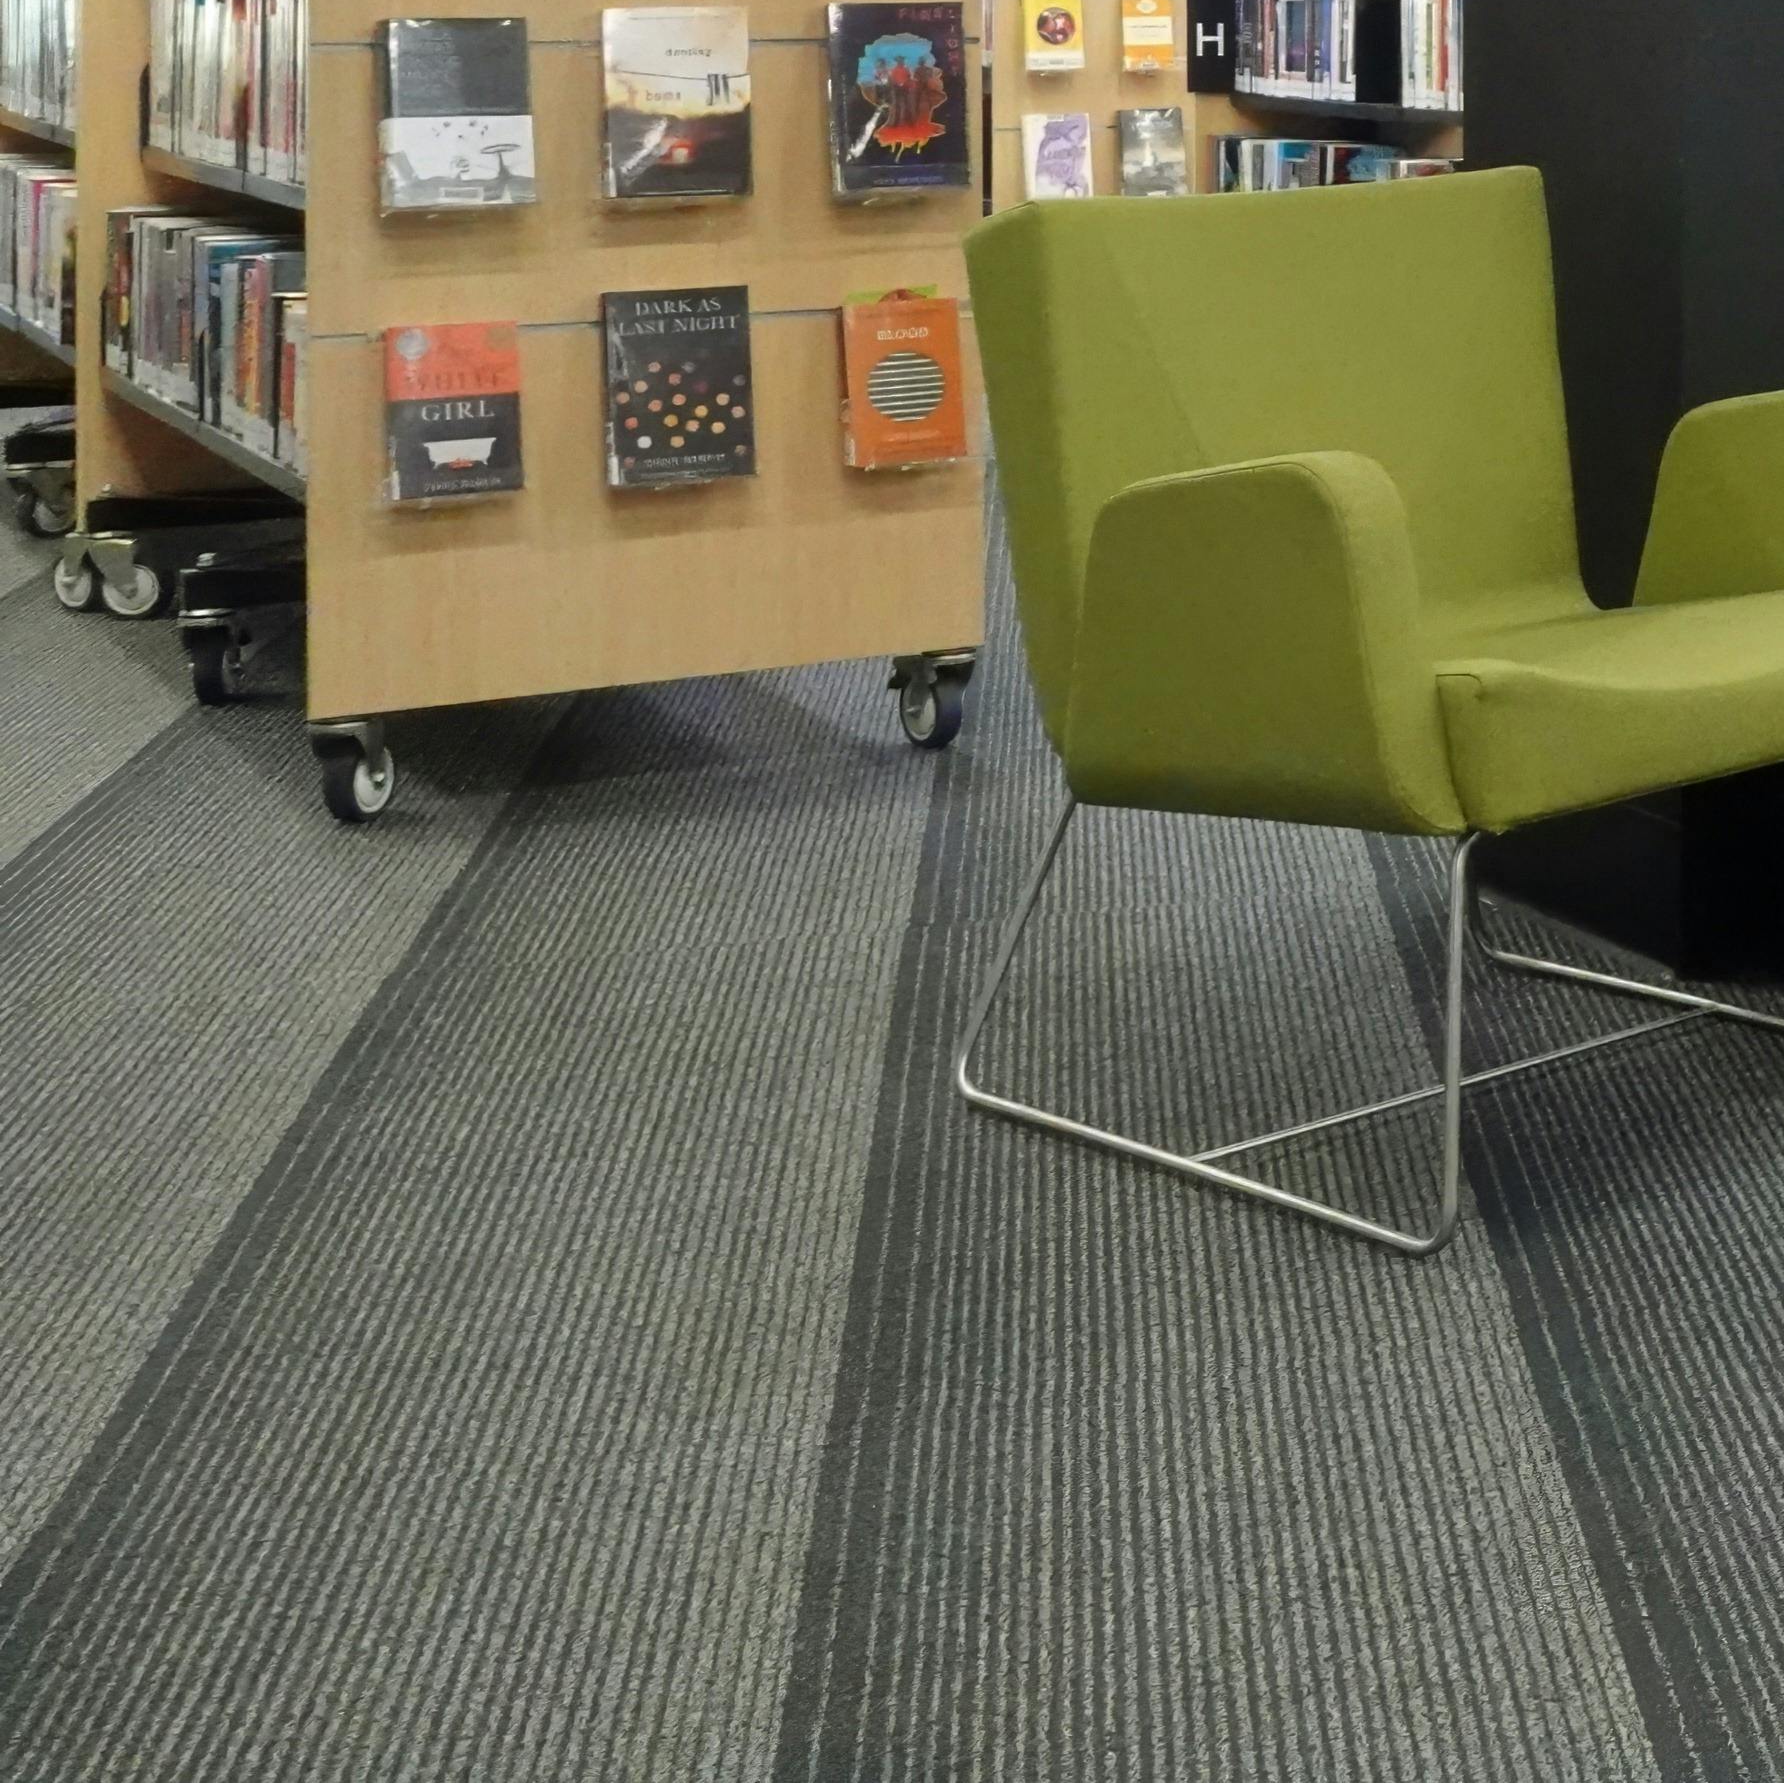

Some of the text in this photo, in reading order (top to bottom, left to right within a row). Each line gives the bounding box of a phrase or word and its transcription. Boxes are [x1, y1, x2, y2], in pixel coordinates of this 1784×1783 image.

[1195, 23, 1225, 57] H
[635, 296, 722, 316] DARK AS
[619, 314, 741, 337] LAST NIGHT
[421, 399, 496, 422] GIRL
